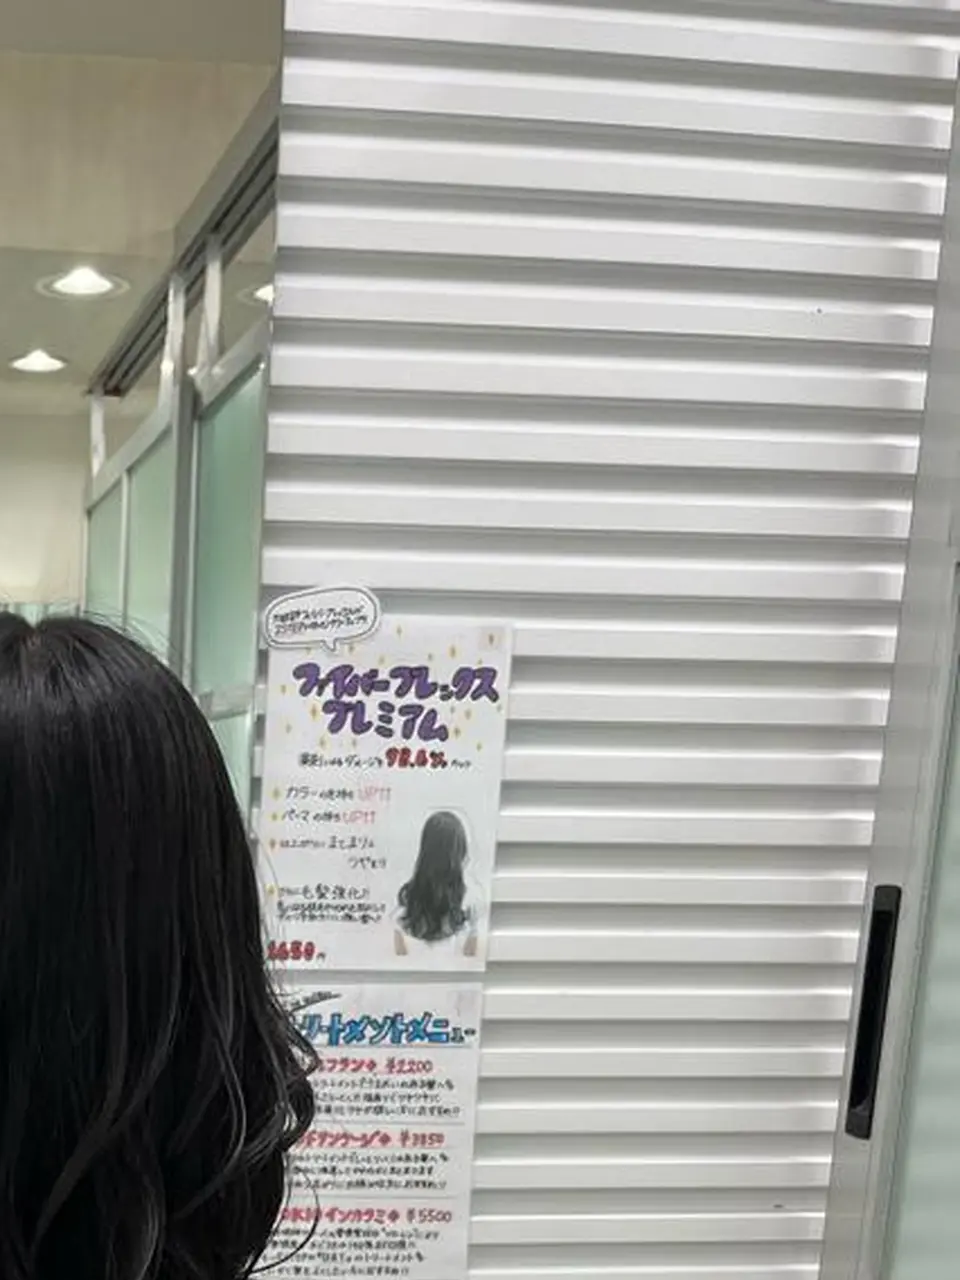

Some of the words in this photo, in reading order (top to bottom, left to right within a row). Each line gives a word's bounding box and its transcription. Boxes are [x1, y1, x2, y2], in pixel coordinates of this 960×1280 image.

[323, 699, 449, 742] プレミアム
[297, 1010, 477, 1046] リートメントメニュー
